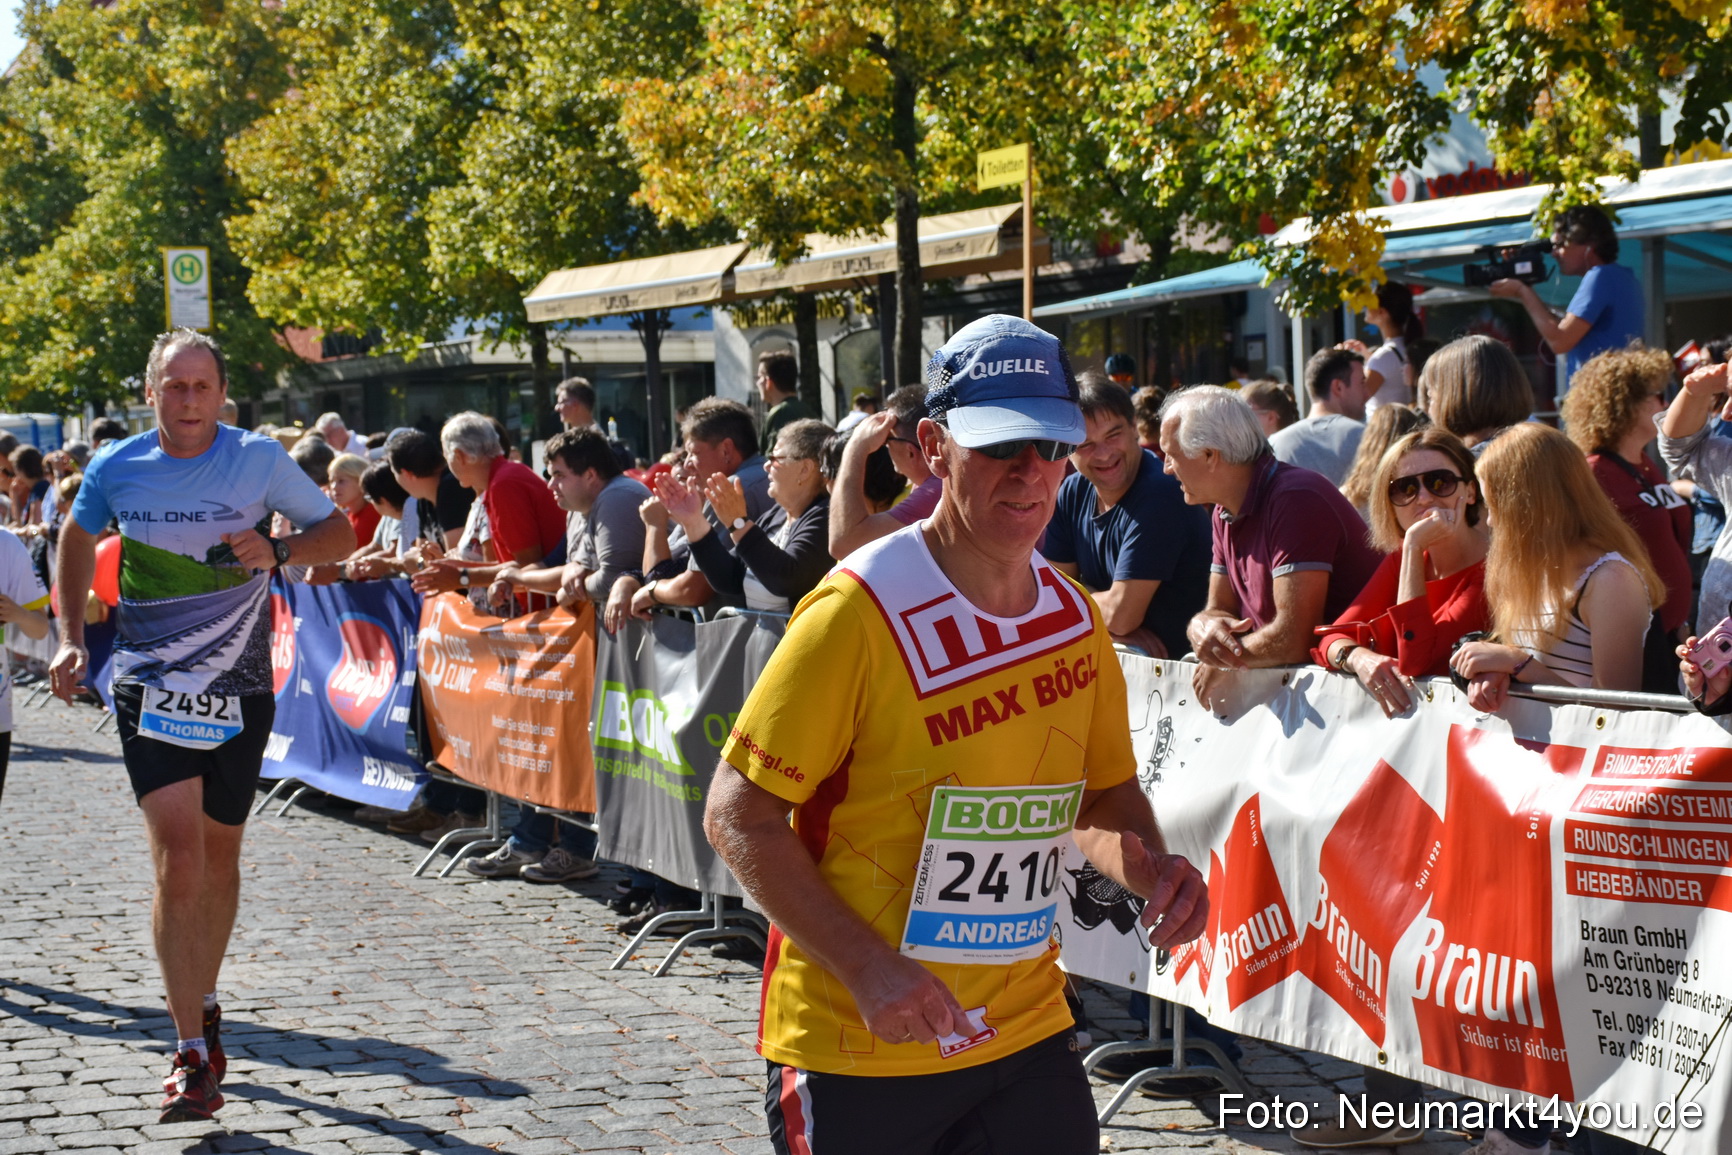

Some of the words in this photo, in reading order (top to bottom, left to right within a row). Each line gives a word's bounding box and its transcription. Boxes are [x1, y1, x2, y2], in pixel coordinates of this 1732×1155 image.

[987, 160, 1025, 177] Toiletten
[180, 261, 194, 277] H
[969, 359, 1050, 380] QUELLE.
[120, 511, 207, 522] RAIL.ONE
[444, 634, 474, 663] CODE
[444, 663, 478, 694] CLINIC
[156, 688, 229, 720] 2492
[924, 684, 1027, 747] MAX
[1032, 653, 1097, 708] BÖGL
[160, 720, 225, 740] THOMAS
[1602, 753, 1697, 776] BINDESTRICKE
[946, 796, 1071, 830] BOCK
[1574, 828, 1730, 862] RUNDSCHLINGEN
[938, 846, 1059, 903] 2410
[1415, 869, 1430, 890] Seit
[1426, 840, 1442, 868] 1929
[1576, 870, 1703, 902] HEBEBÄNDER
[934, 915, 1048, 944] ANDREAS
[1219, 903, 1289, 977] Braun
[1309, 872, 1382, 998] Braun
[1581, 920, 1628, 945] Braun
[1634, 925, 1687, 950] GmbH
[1245, 957, 1269, 976] Sicher
[1269, 951, 1279, 964] ist
[1279, 938, 1300, 957] sicher
[1410, 916, 1546, 1029] Braun
[1584, 947, 1609, 969] Am
[1614, 950, 1688, 983] Grünberg
[1693, 959, 1700, 980] 8
[1335, 960, 1355, 991] Sicher
[1355, 984, 1366, 1001] ist
[1586, 973, 1652, 999] D-92318
[1592, 1009, 1622, 1032] Tel.
[1626, 1013, 1664, 1040] 09181
[1461, 1023, 1499, 1049] Sicher
[1503, 1033, 1523, 1053] ist
[1525, 1039, 1568, 1062] sicher
[1598, 1035, 1626, 1058] Fax
[1630, 1040, 1663, 1068] 09181
